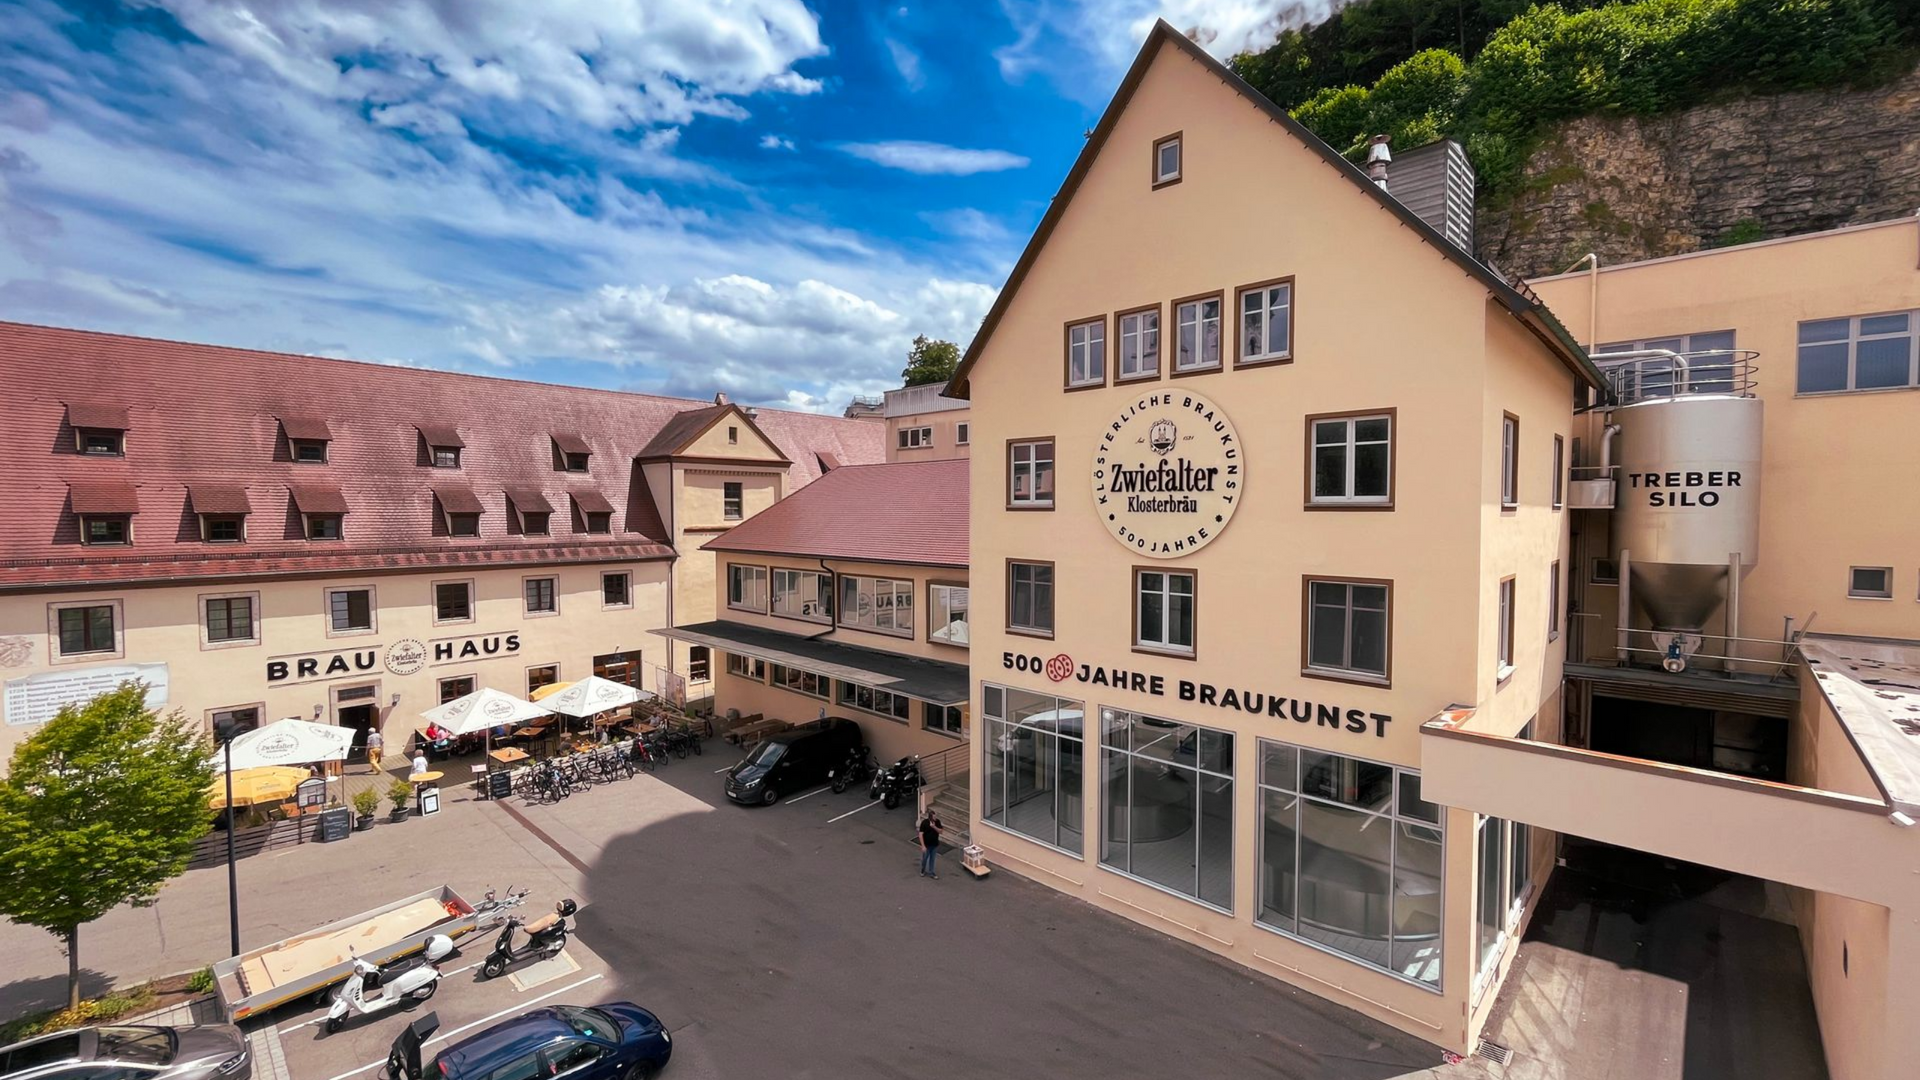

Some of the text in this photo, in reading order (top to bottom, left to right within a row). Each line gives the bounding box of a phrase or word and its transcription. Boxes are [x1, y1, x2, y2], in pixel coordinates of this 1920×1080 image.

[1093, 394, 1238, 505] KLÖSTERLICHE BRAUKUNST
[1110, 458, 1218, 493] Zwiefalter
[1629, 471, 1741, 488] TREBER
[1127, 494, 1198, 513] Klosterbräu
[1649, 491, 1720, 507] SILO
[1118, 526, 1208, 553] 500 JAHRE
[267, 651, 376, 682] BRAU
[435, 635, 520, 661] HAUS
[1003, 650, 1392, 738] 500 JAHRE BRAUKUNST
